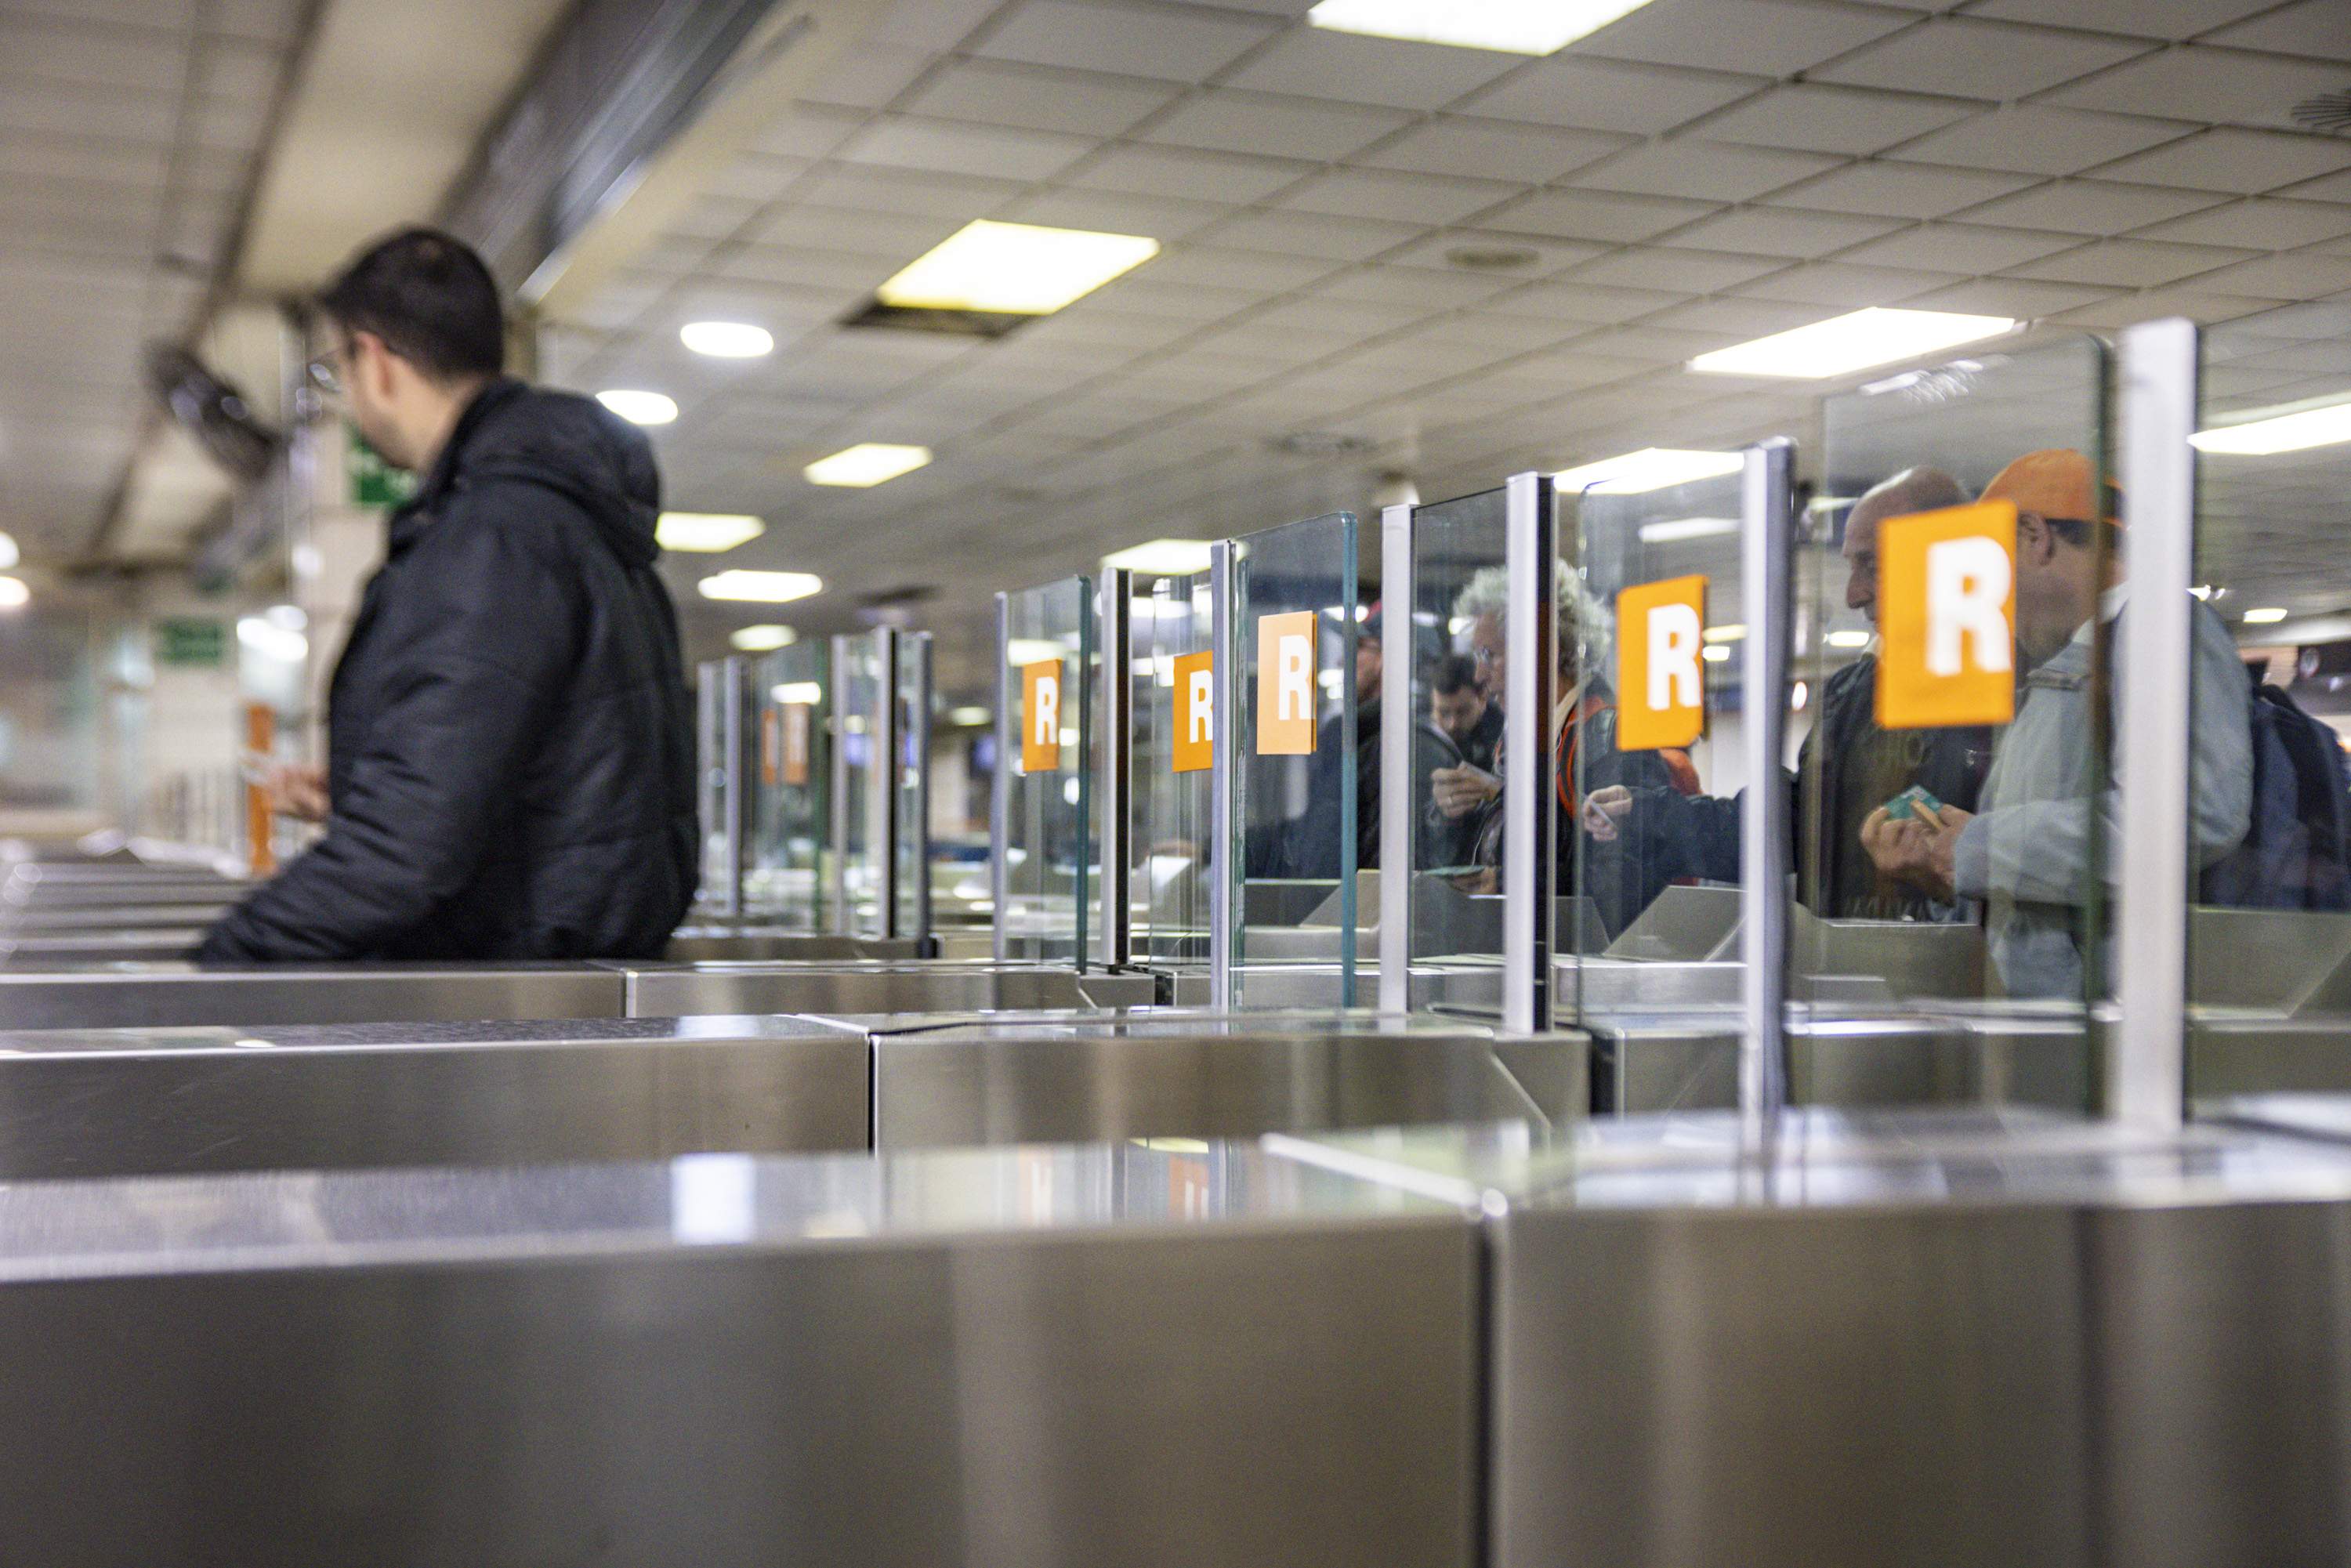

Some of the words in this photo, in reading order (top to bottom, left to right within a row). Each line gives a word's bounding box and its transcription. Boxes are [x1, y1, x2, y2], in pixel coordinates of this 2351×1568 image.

[1925, 535, 2012, 677] R
[1278, 635, 1313, 720] R
[1647, 603, 1701, 711] R
[1036, 677, 1057, 744] R
[1190, 670, 1212, 743] R
